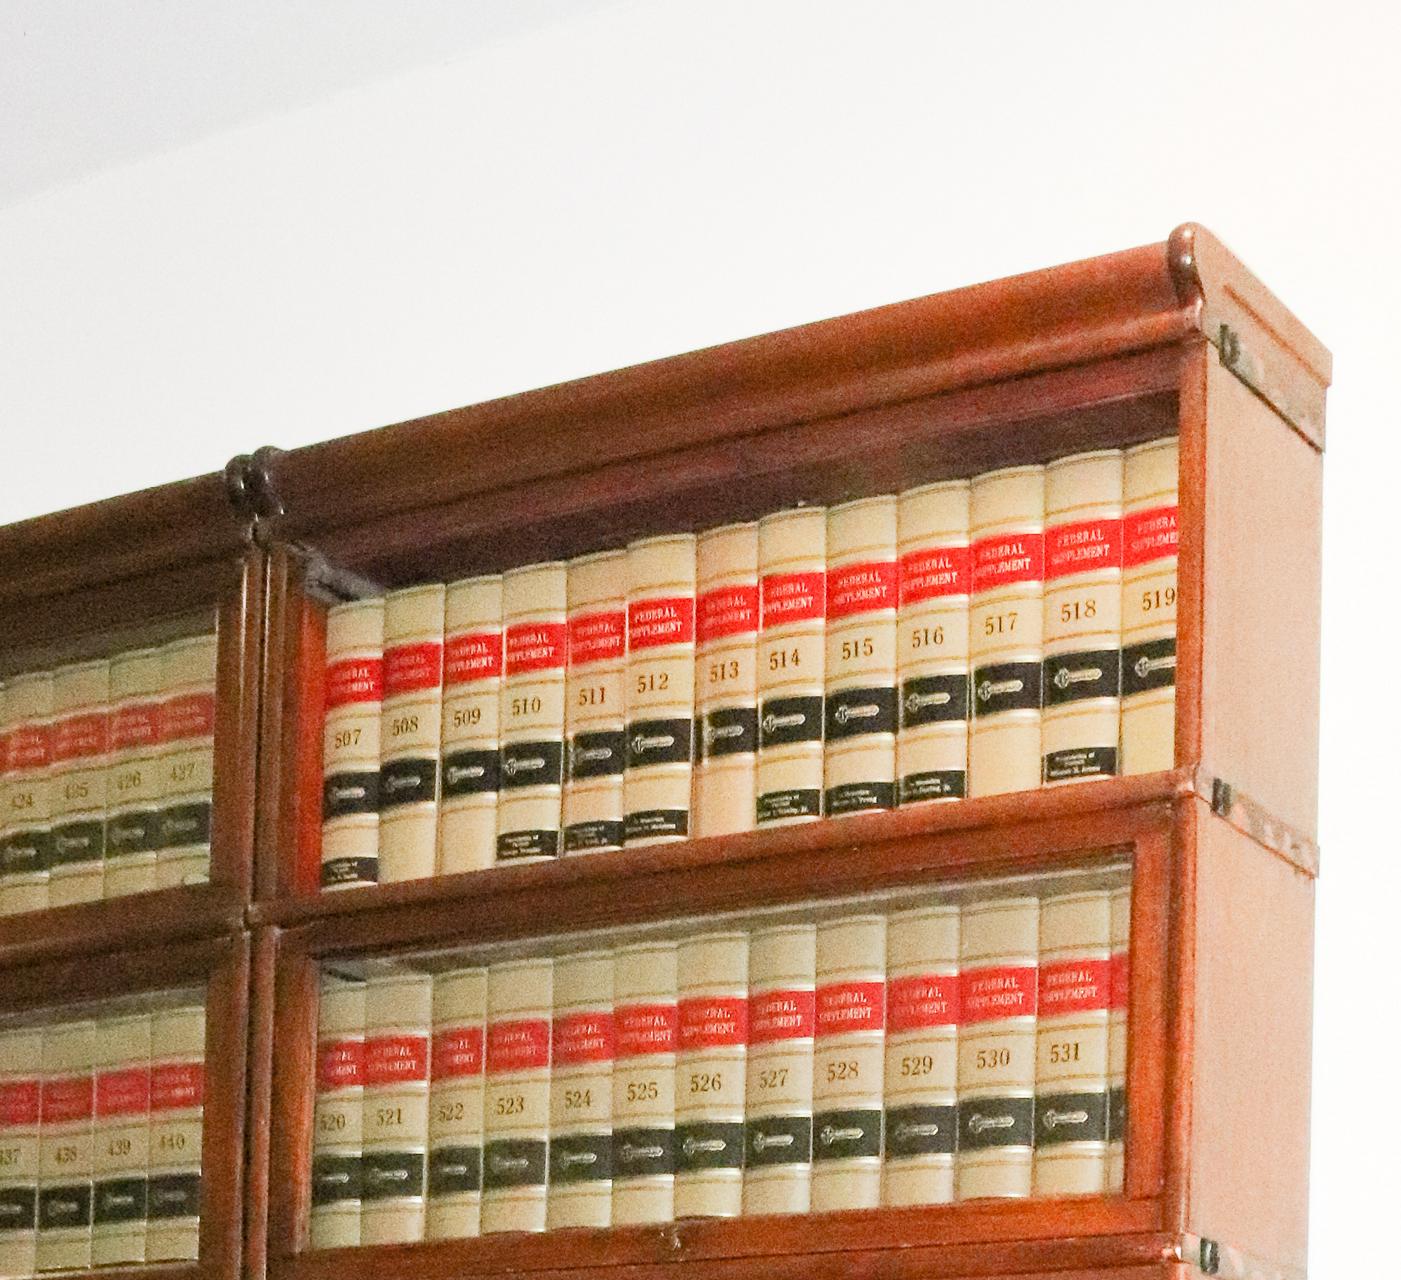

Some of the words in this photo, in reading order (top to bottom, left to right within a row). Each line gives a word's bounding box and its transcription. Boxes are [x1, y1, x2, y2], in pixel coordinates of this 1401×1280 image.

[1057, 528, 1105, 546] FEDERAL
[1142, 591, 1176, 611] 519
[634, 606, 677, 622] FEDERAL
[1061, 600, 1096, 622] 518
[985, 613, 1017, 635] 517
[912, 627, 944, 647] 516
[842, 640, 874, 659] 515
[770, 650, 801, 670] 514
[710, 661, 739, 682] 513
[638, 673, 669, 693] 512
[512, 697, 541, 715] 510
[579, 688, 605, 706] 511
[393, 716, 418, 736] 508
[454, 708, 481, 726] 509
[335, 729, 361, 748] 507
[977, 1050, 1010, 1068] 530
[1051, 1043, 1081, 1062] 531
[828, 1062, 858, 1080] 528
[901, 1056, 933, 1075] 529
[690, 1074, 722, 1092] 526
[759, 1070, 788, 1089] 527
[565, 1092, 591, 1109] 524
[627, 1082, 658, 1101] 525
[439, 1103, 463, 1121] 522
[497, 1098, 524, 1114] 523
[320, 1114, 345, 1131] 520
[376, 1109, 402, 1125] 521
